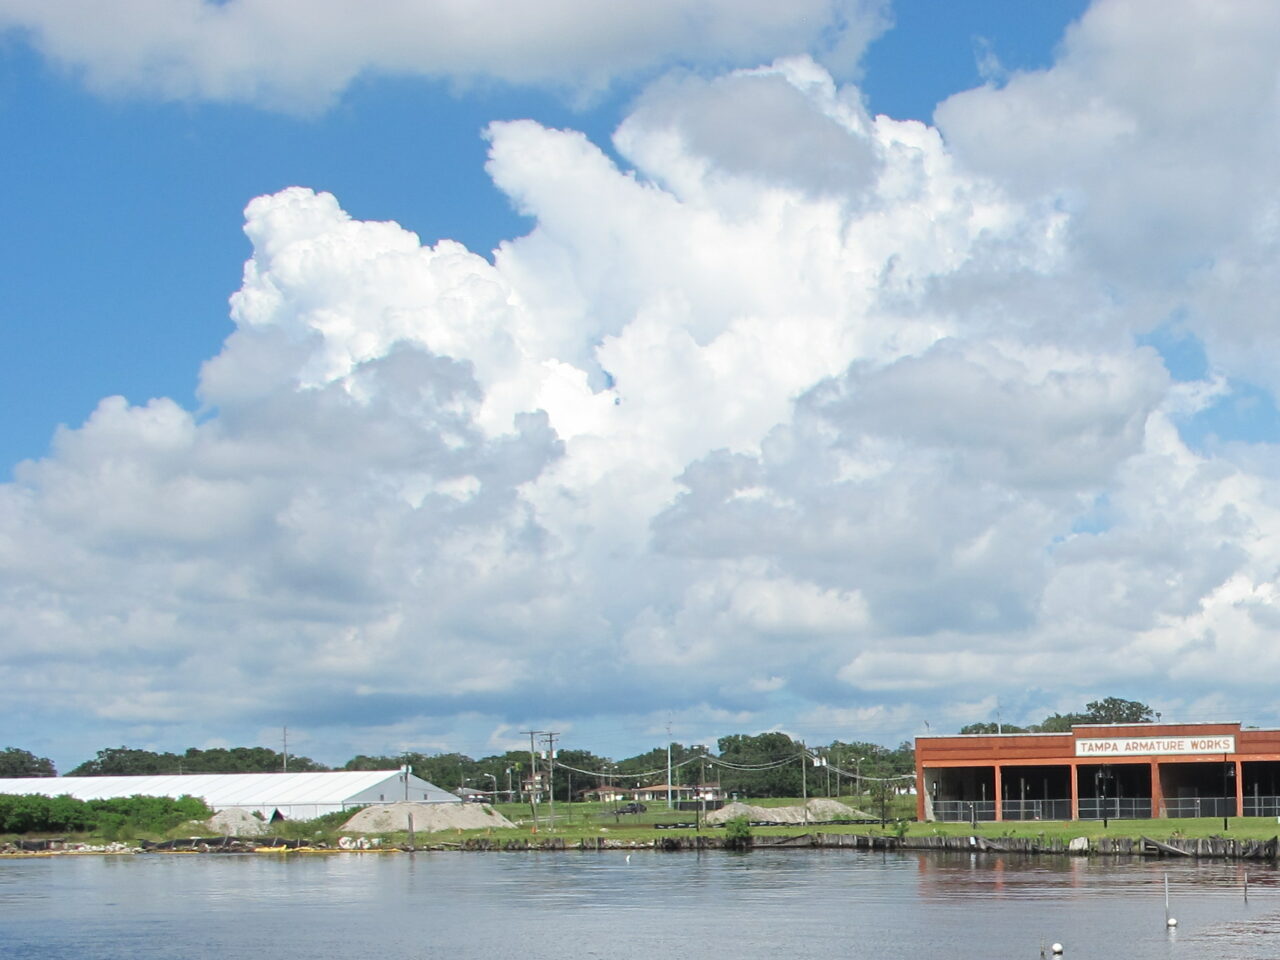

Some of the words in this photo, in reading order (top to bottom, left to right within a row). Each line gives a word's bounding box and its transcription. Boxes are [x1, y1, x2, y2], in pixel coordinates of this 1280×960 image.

[1081, 742, 1118, 752] TAMPA
[1125, 740, 1184, 751] ARMATURE
[1190, 739, 1230, 750] WORKS
